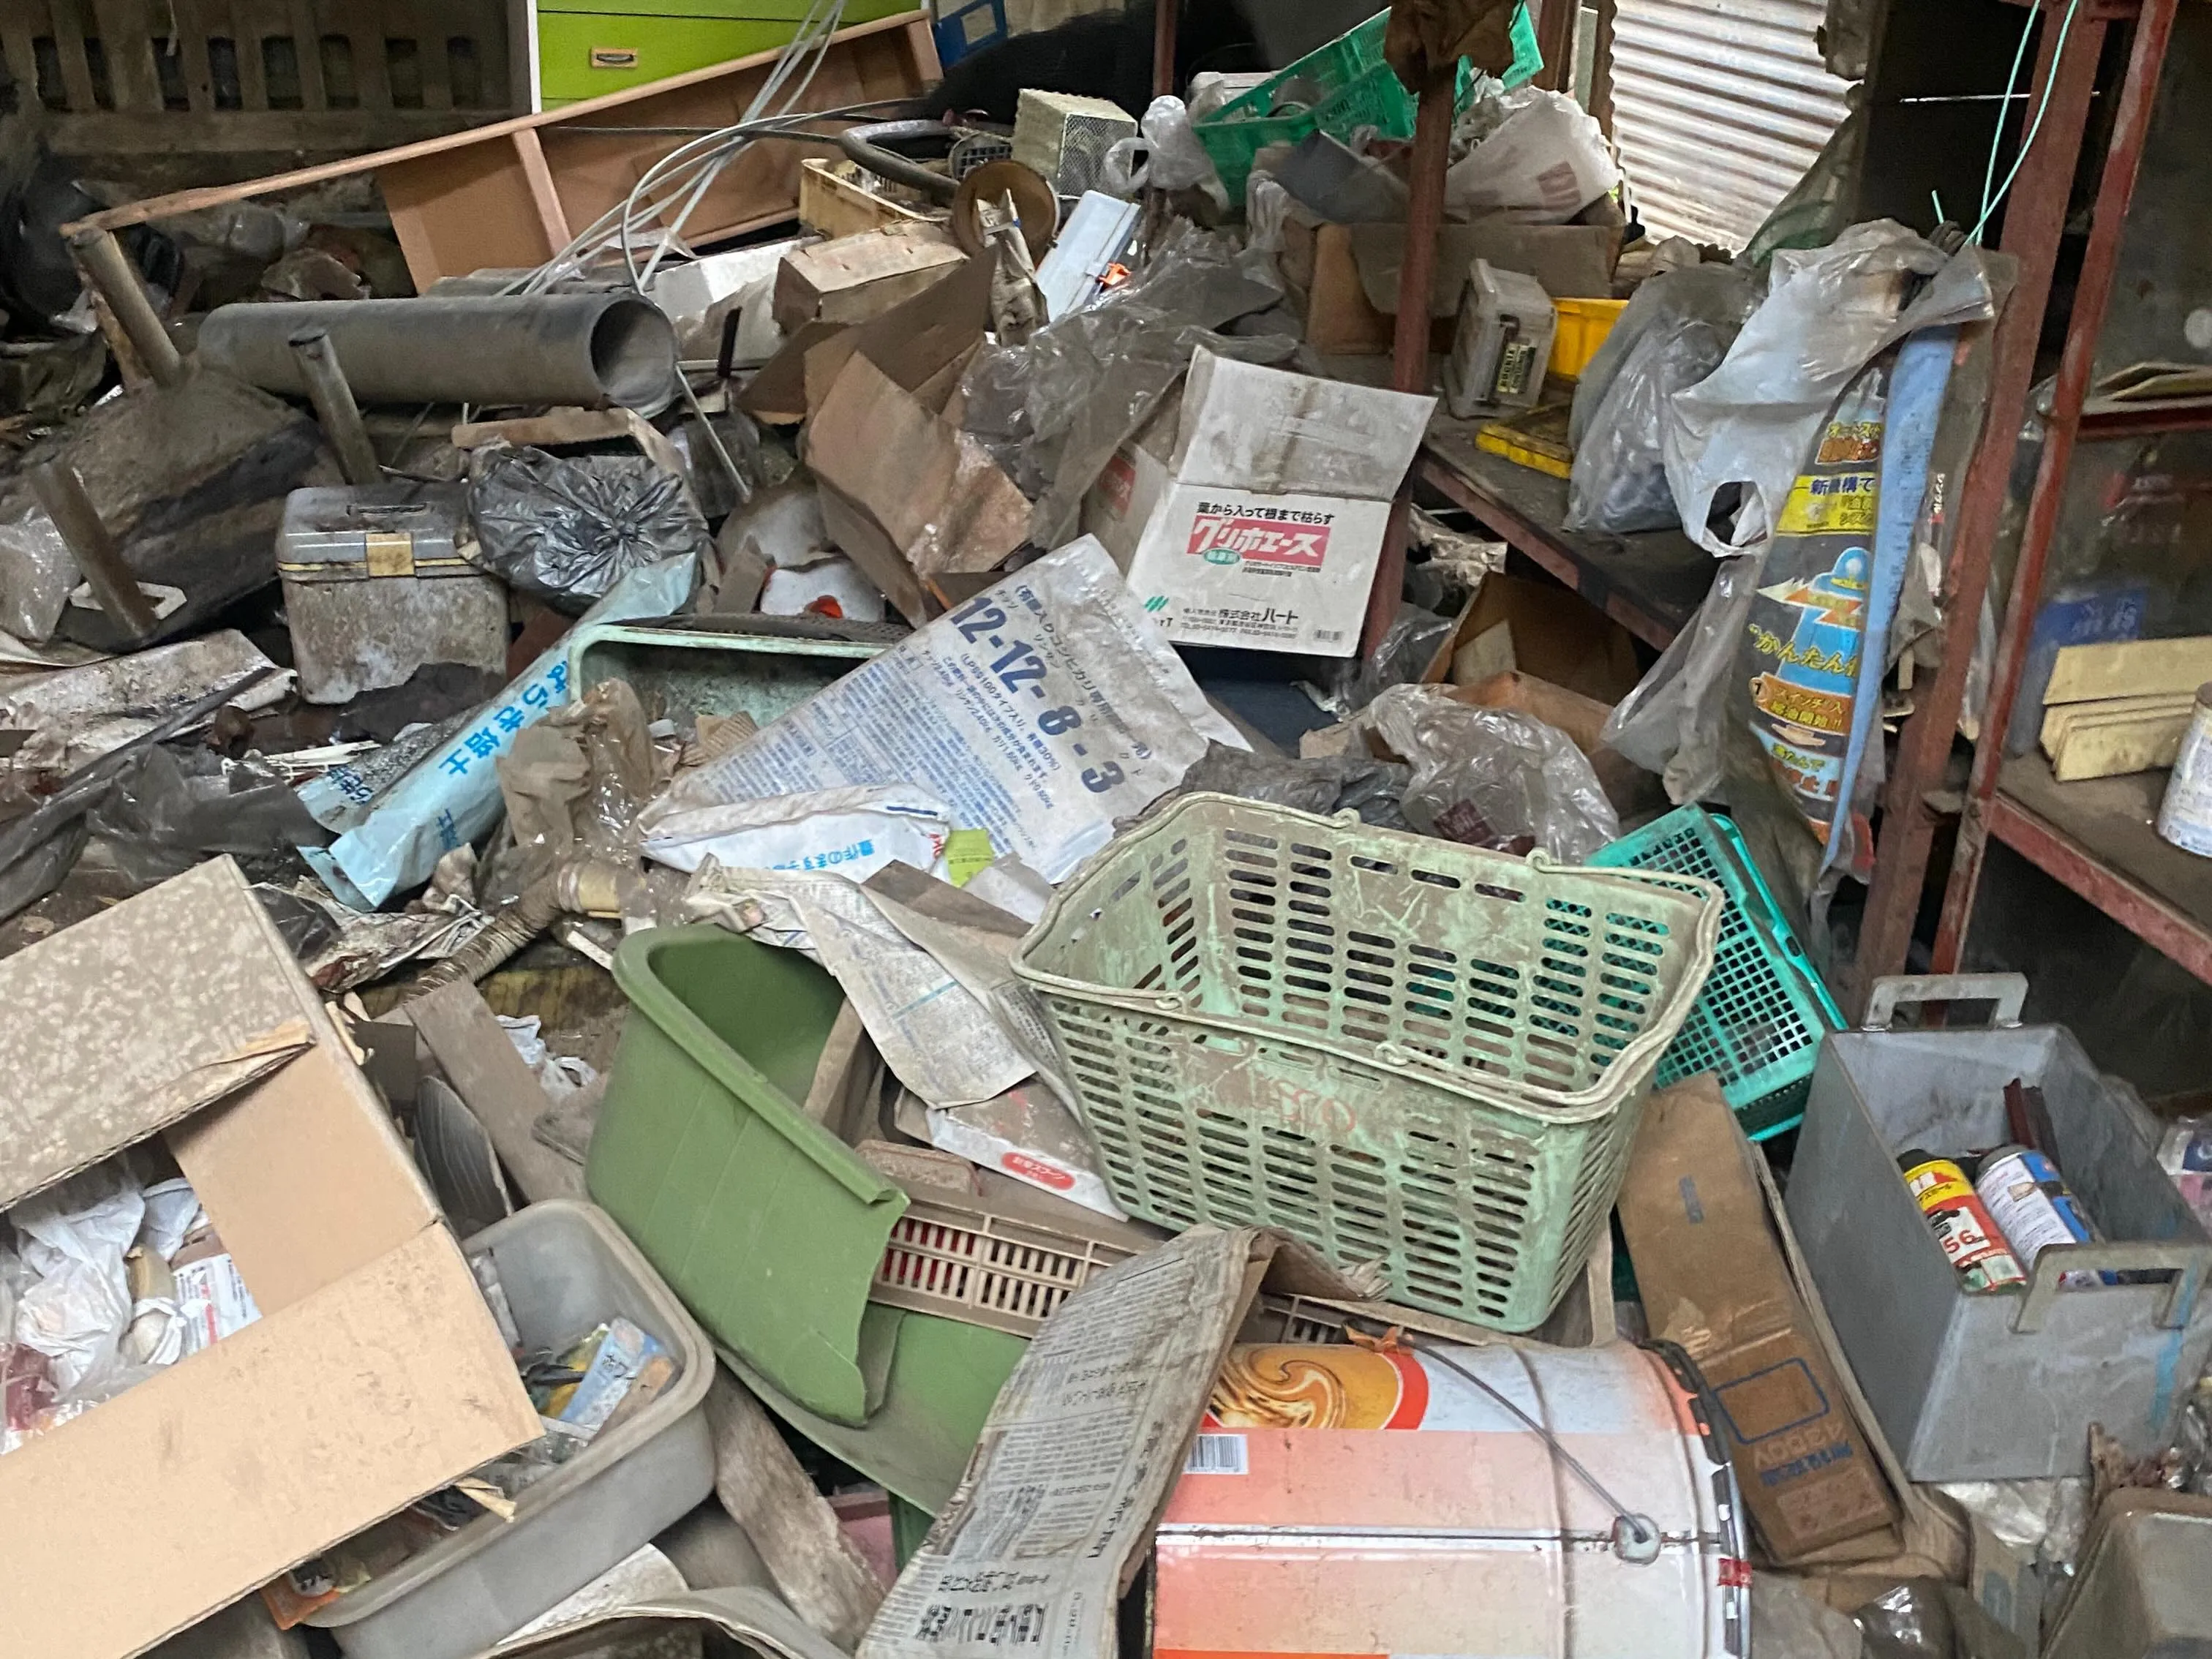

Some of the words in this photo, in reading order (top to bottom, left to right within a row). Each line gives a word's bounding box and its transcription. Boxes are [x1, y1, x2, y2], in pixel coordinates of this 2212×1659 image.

[1197, 502, 1336, 525] 葉から入って根まで枯らす
[1194, 518, 1323, 558] グリホエース
